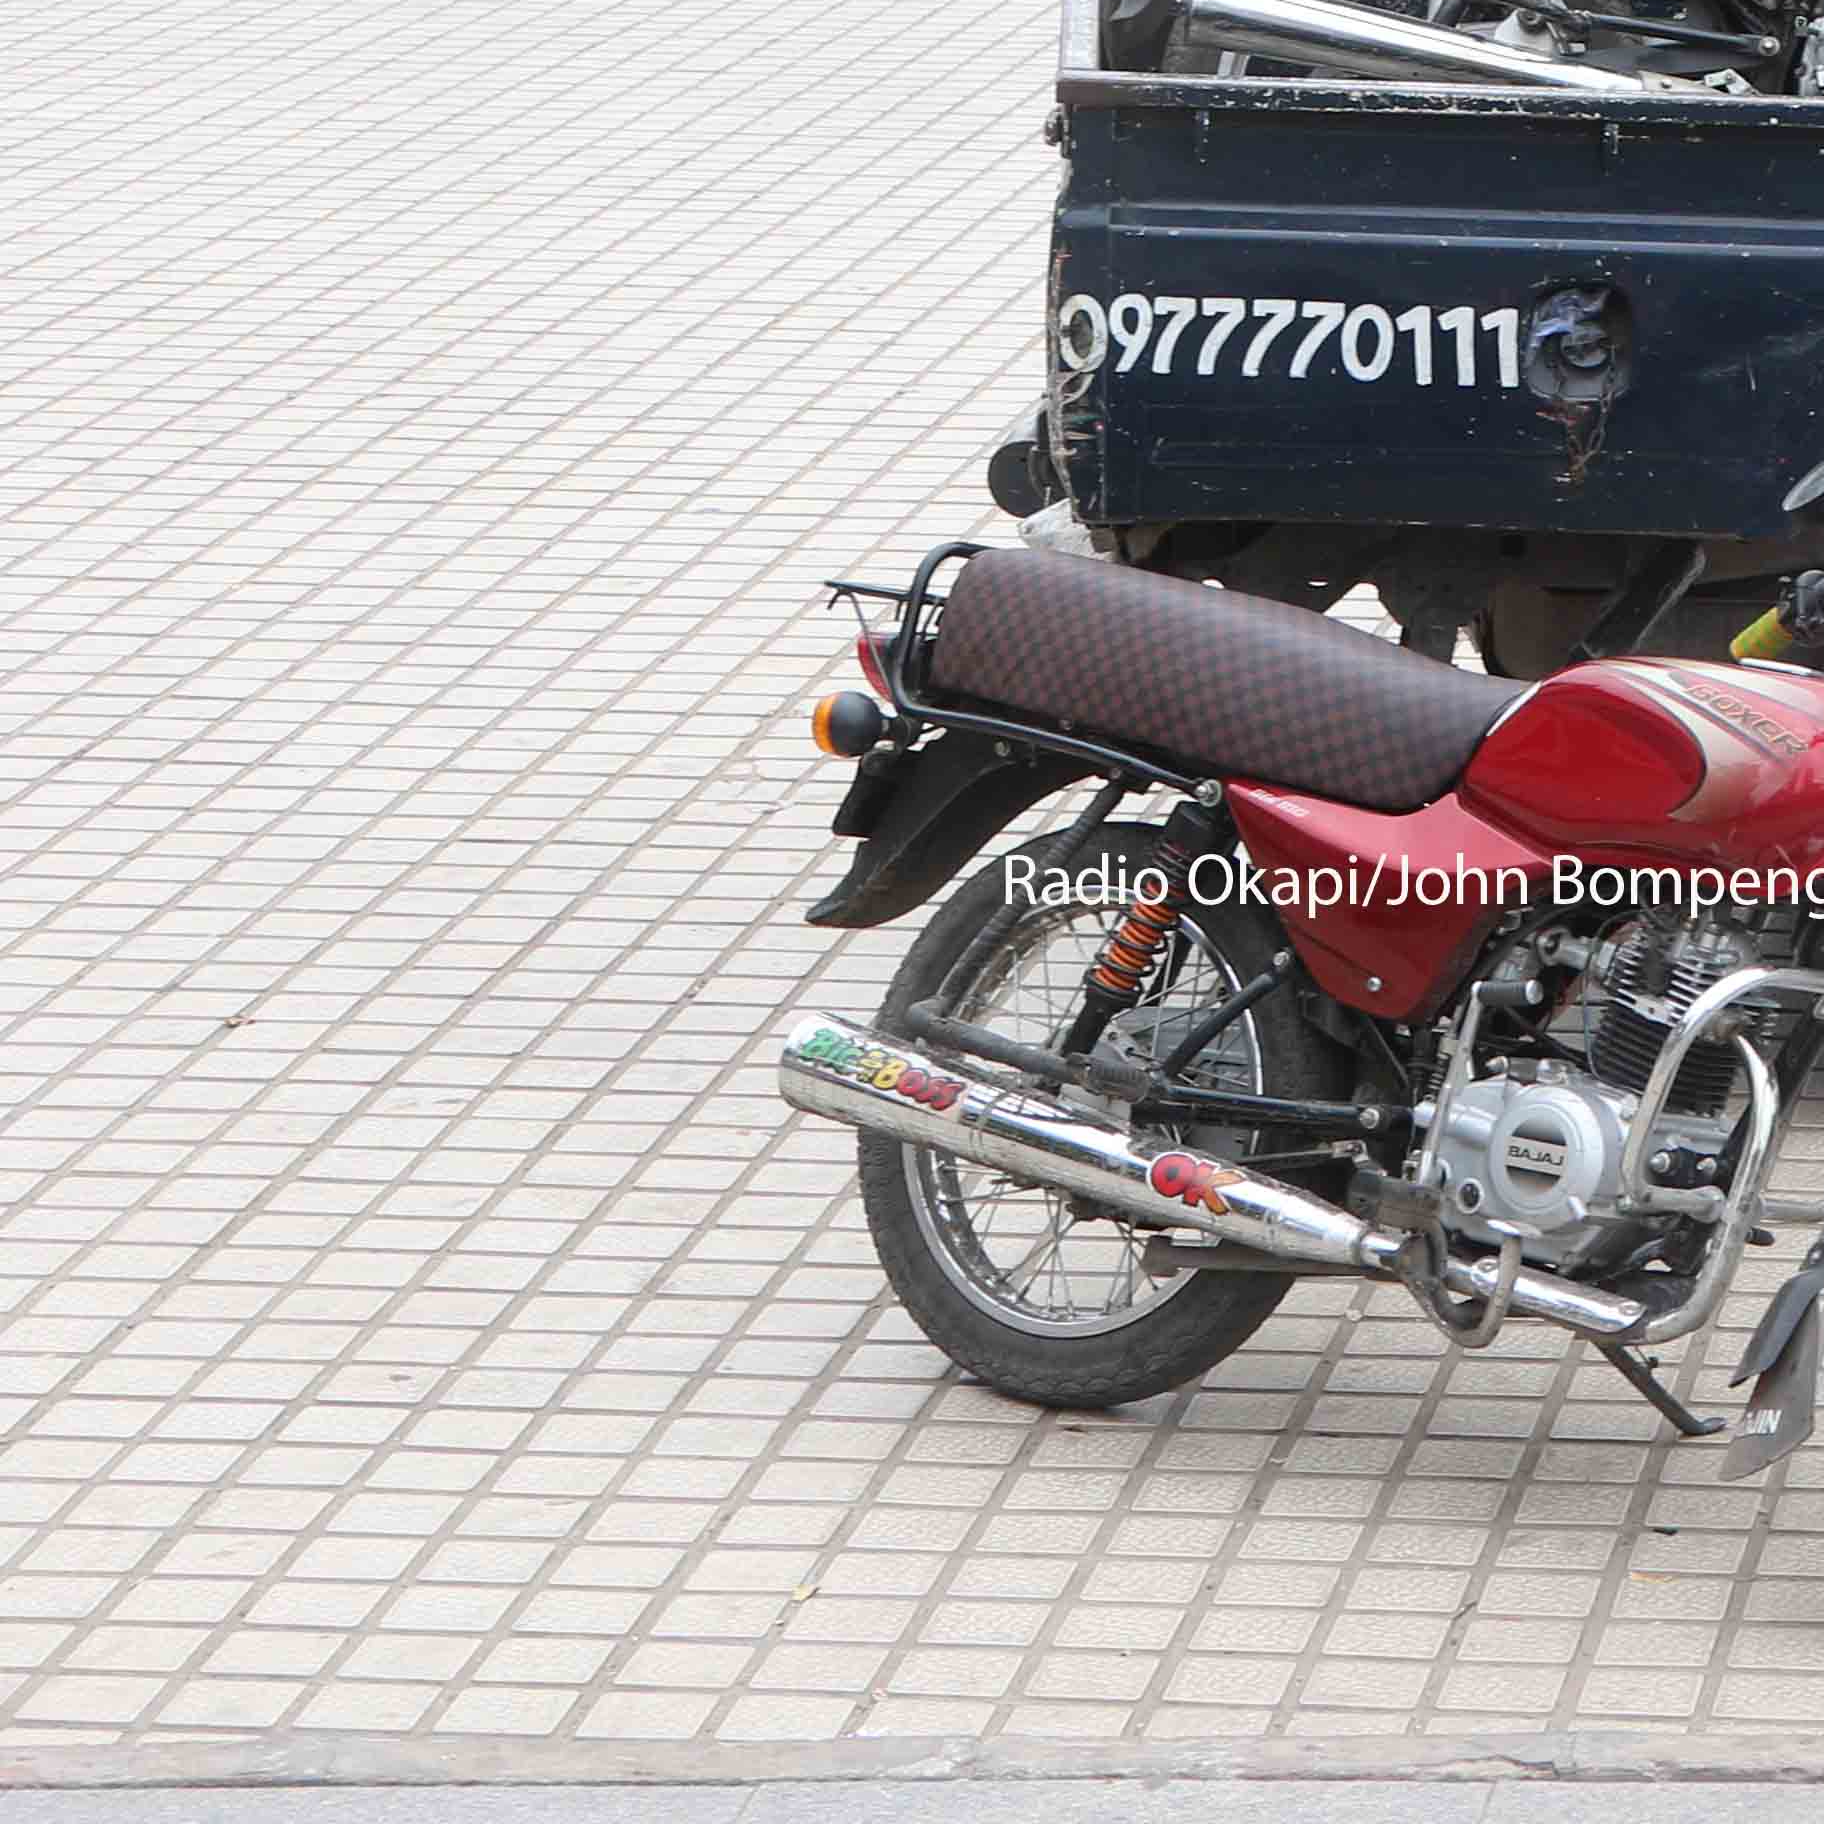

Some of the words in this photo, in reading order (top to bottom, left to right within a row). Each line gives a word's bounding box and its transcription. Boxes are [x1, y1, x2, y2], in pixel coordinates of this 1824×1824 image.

[1059, 294, 1519, 388] 0977770111
[1148, 1152, 1247, 1216] OK
[1507, 1145, 1565, 1166] BAJAJ
